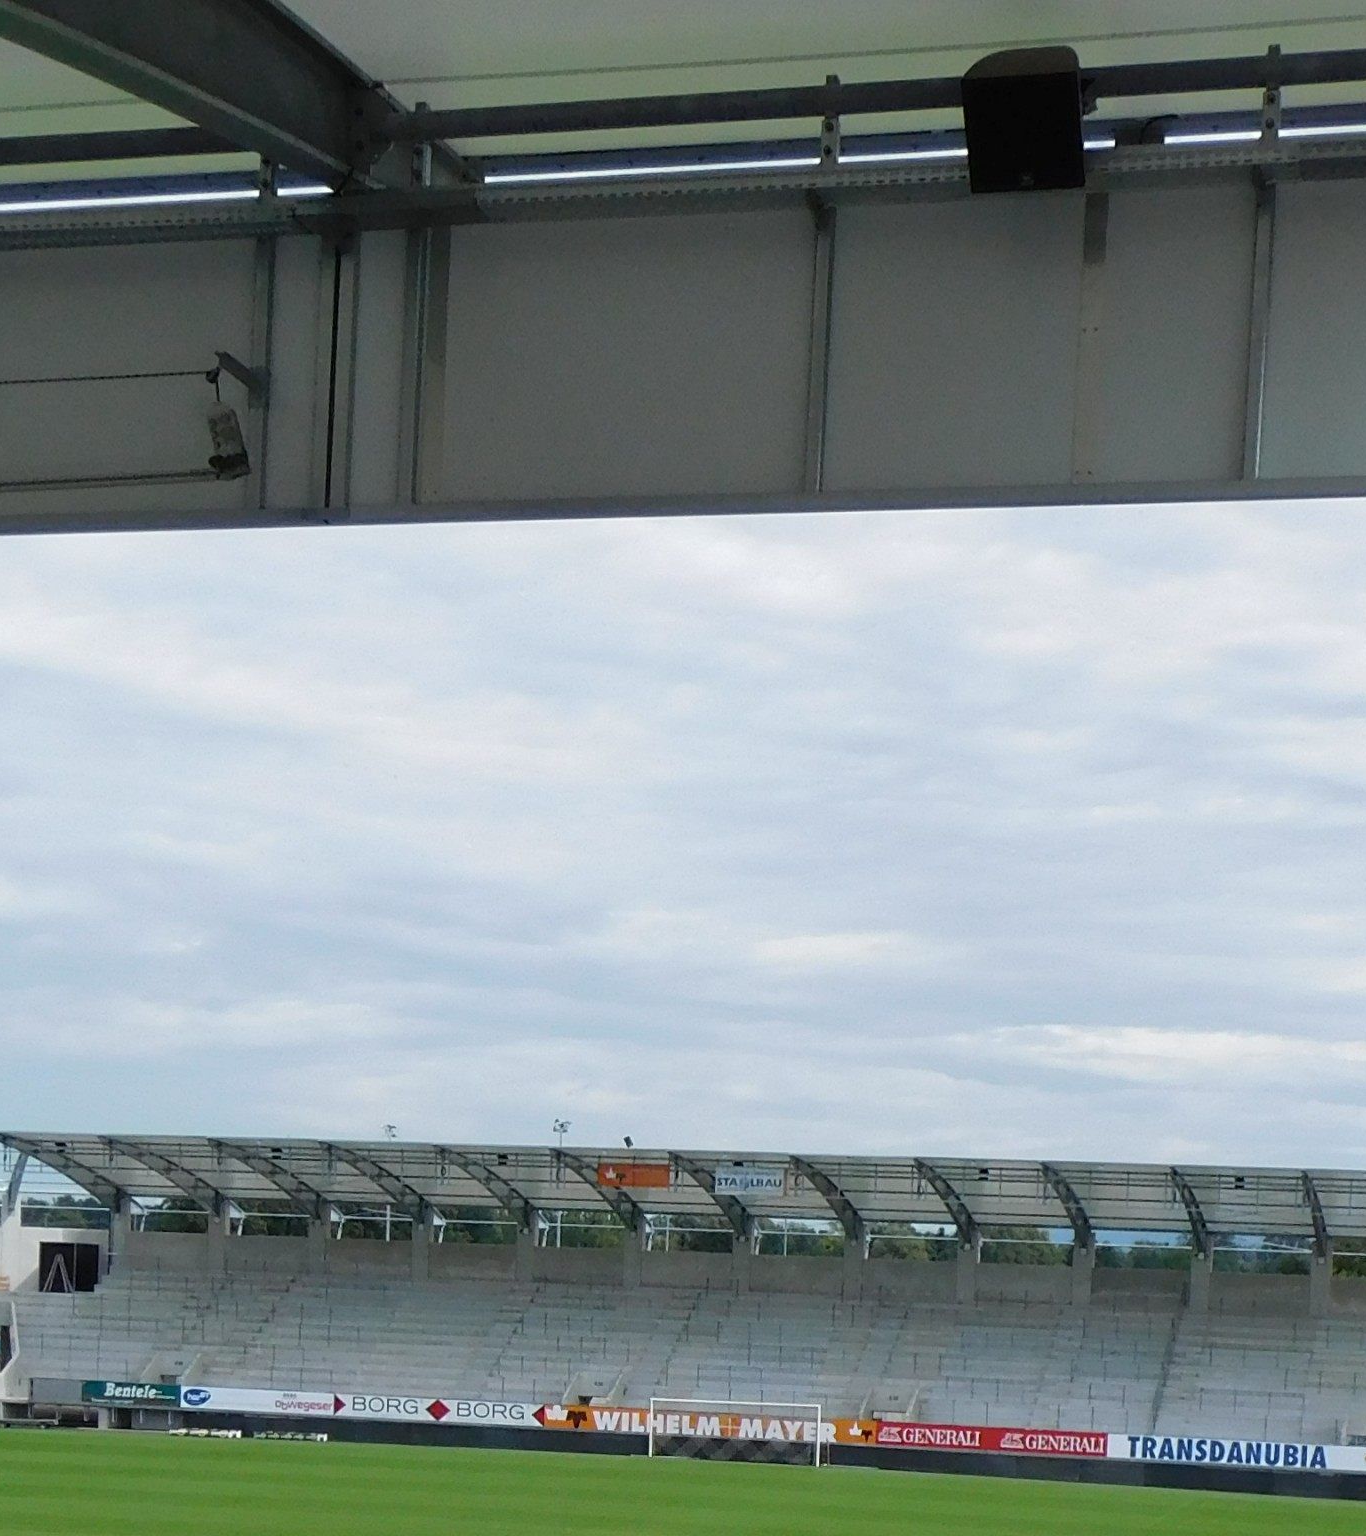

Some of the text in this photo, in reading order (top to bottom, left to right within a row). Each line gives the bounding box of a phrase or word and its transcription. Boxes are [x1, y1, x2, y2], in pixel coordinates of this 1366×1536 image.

[104, 1382, 157, 1399] Bentele
[351, 1396, 419, 1415] BORG
[456, 1402, 525, 1420] BORG
[592, 1410, 721, 1437] WILHELM
[738, 1418, 837, 1443] MAYER
[902, 1428, 981, 1447] GENERALI
[1025, 1434, 1105, 1454] GENERALI
[1128, 1436, 1327, 1469] TRANSDANUBIA
